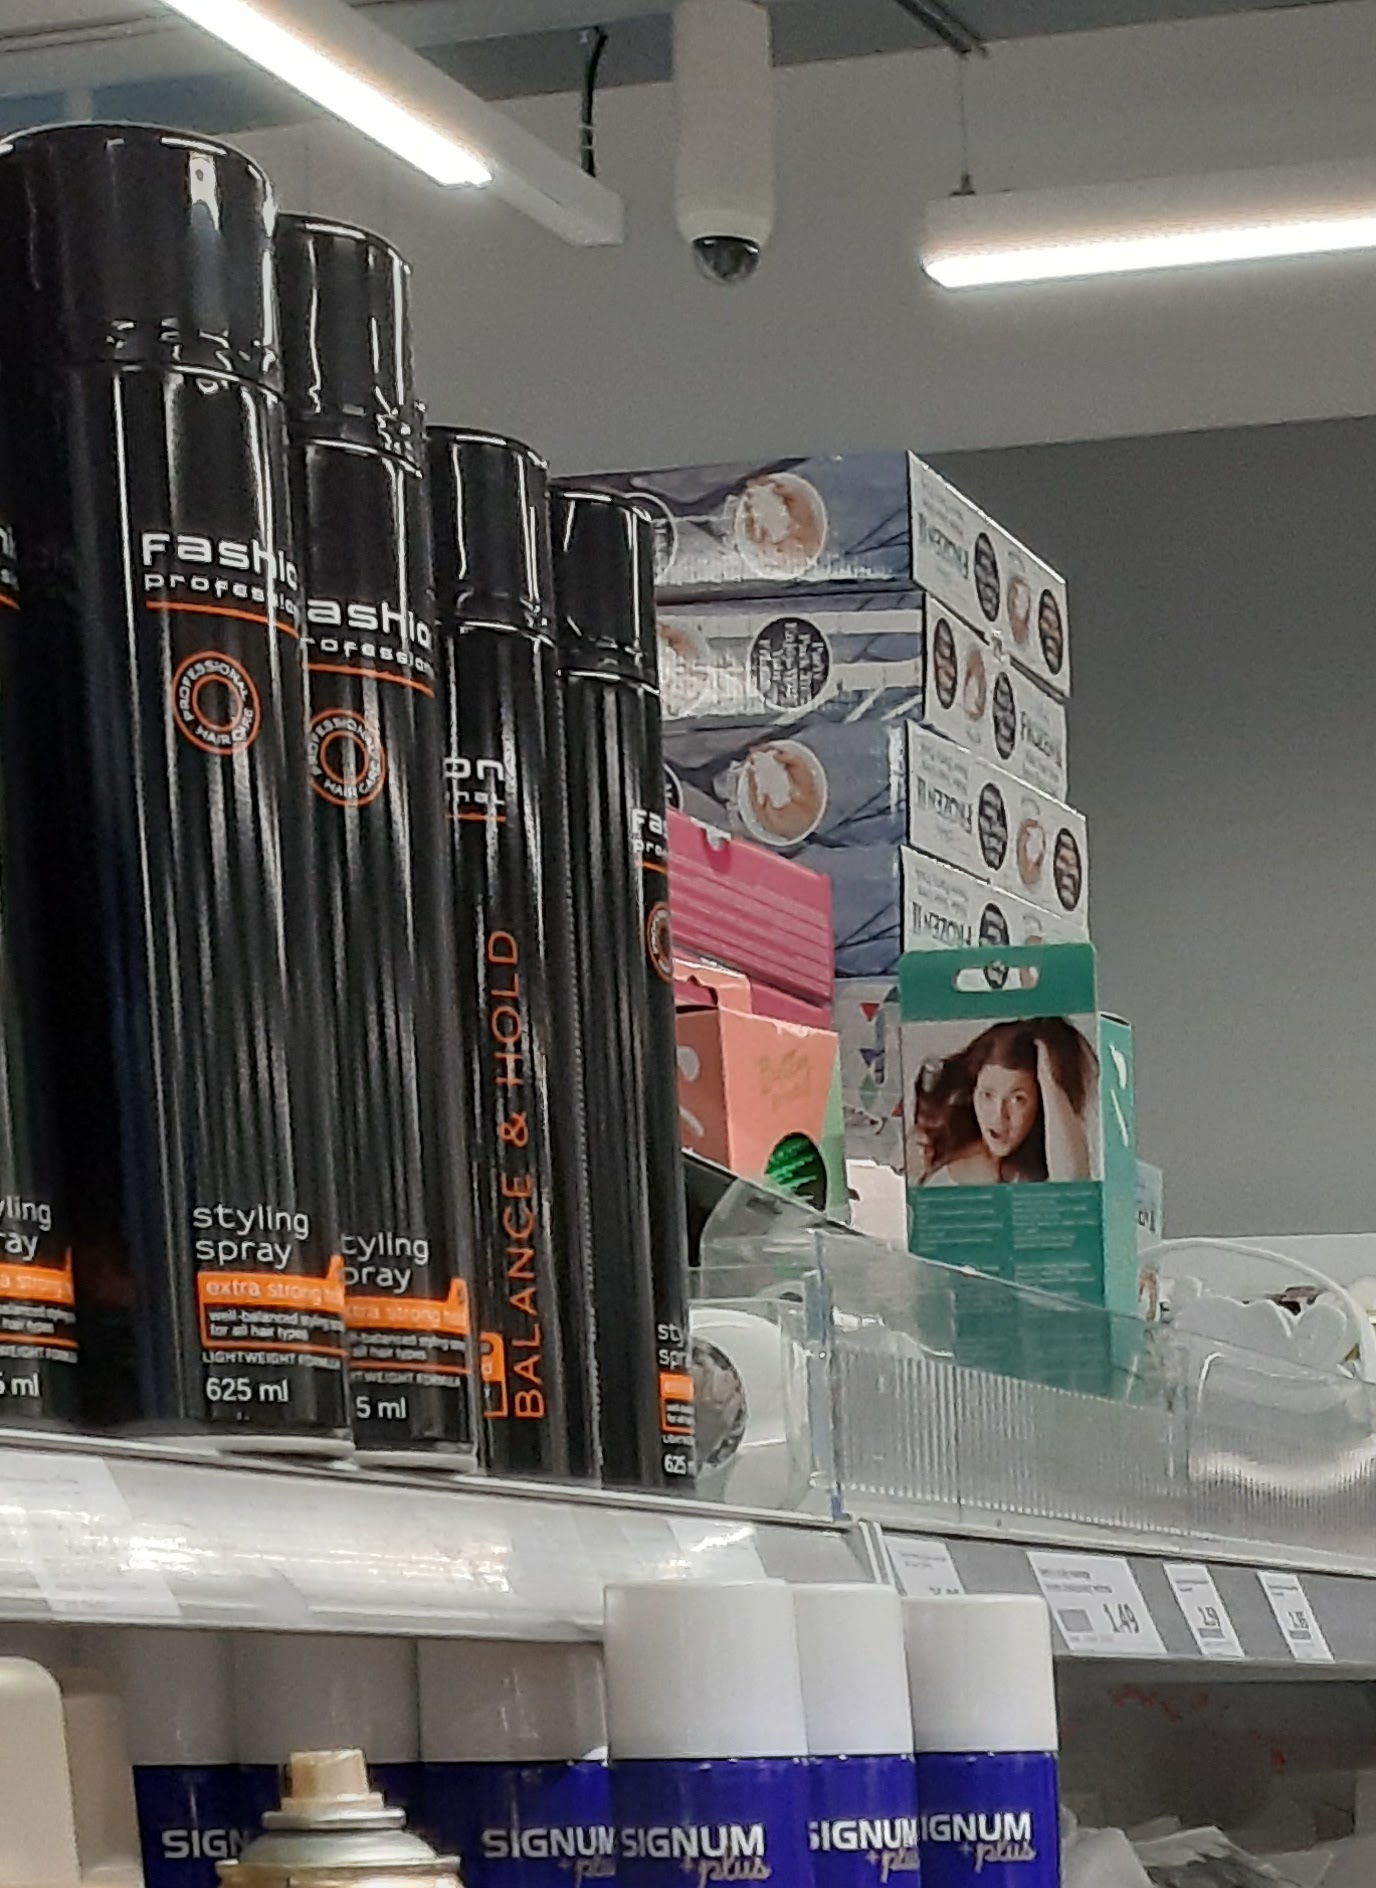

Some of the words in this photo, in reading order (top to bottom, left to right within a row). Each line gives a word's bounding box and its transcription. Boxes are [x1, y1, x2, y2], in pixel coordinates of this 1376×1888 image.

[486, 930, 523, 1087] HOLD
[497, 1111, 528, 1148] &
[193, 1203, 310, 1240] styling
[195, 1238, 292, 1269] spray
[205, 1279, 261, 1298] extra
[267, 1283, 322, 1306] strong
[501, 1171, 546, 1419] BALANCE
[205, 1376, 251, 1402] 625
[258, 1378, 290, 1403] ml
[356, 1396, 371, 1419] 5
[378, 1396, 407, 1420] ml
[1103, 1602, 1141, 1634] 1.49
[619, 1823, 766, 1859] SIGNUM
